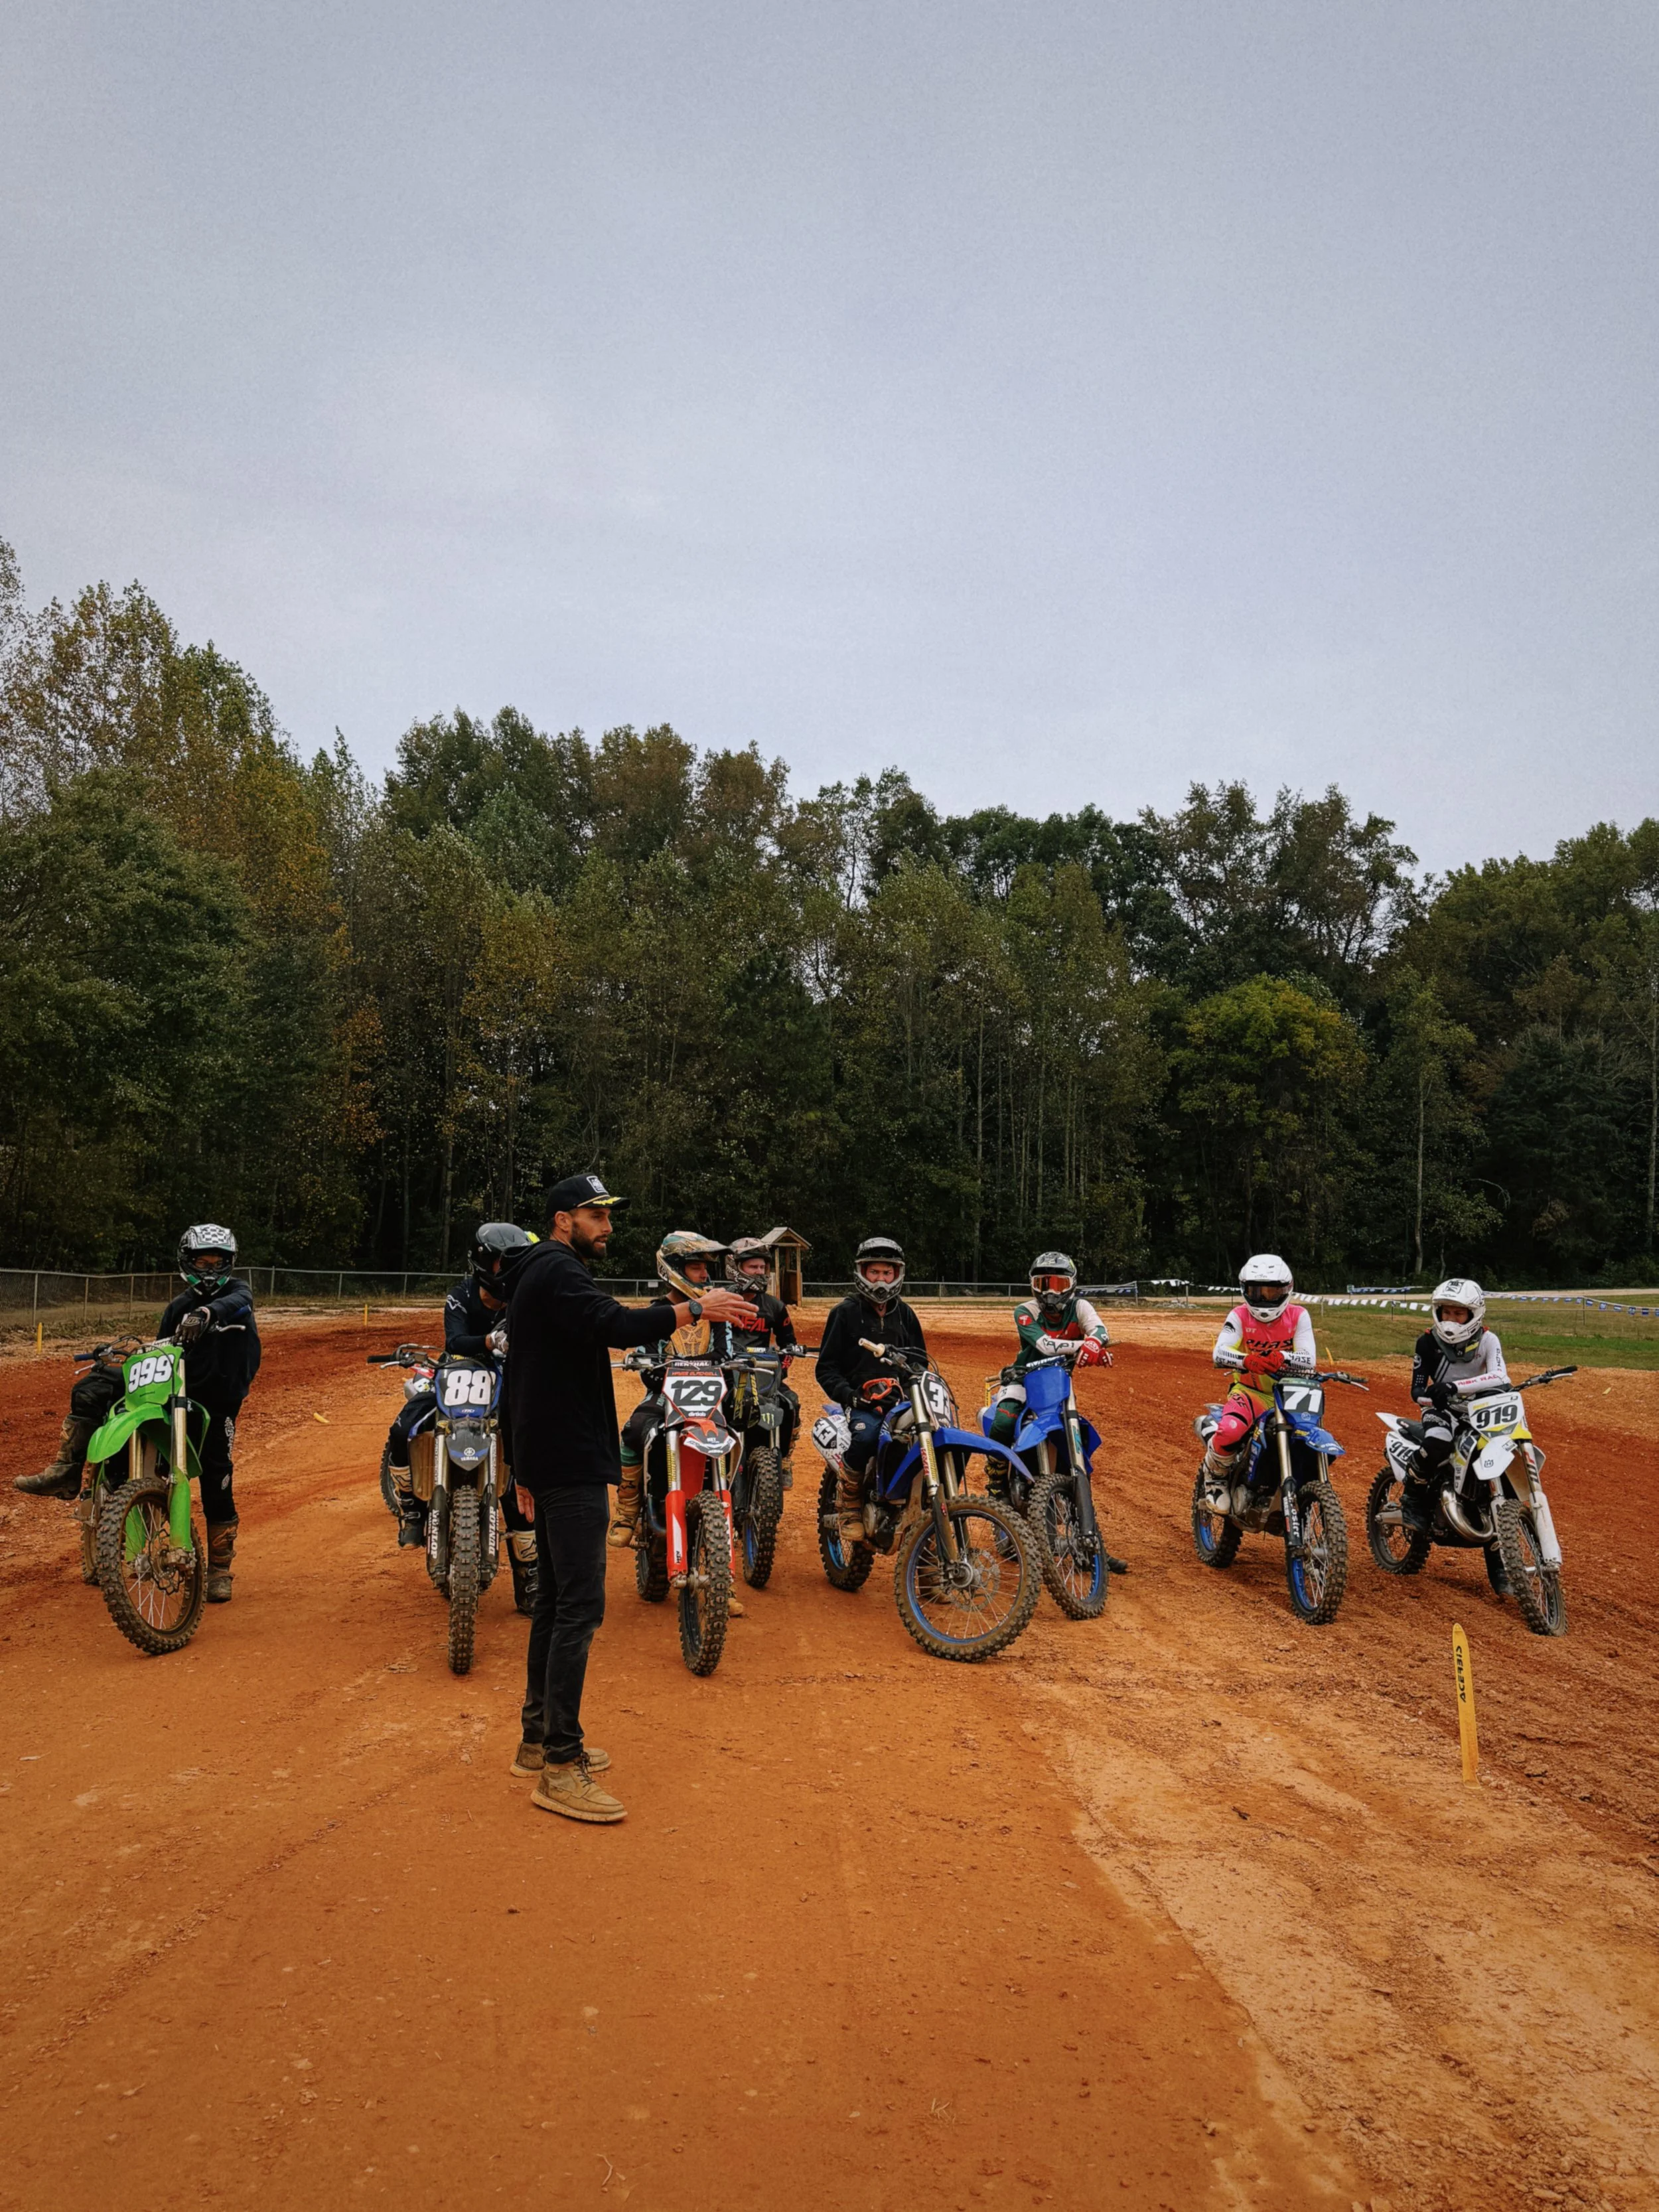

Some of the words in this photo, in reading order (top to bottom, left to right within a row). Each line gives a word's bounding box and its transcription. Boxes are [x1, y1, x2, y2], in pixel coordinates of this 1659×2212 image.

[1246, 1338, 1294, 1349] PHAS
[128, 1355, 175, 1394] 999
[444, 1369, 496, 1406] 88
[671, 1380, 723, 1406] 129
[1283, 1386, 1323, 1413] 71
[1476, 1404, 1518, 1429] 919
[814, 1418, 836, 1447] 33
[1456, 1645, 1467, 1703] ACERBIS
